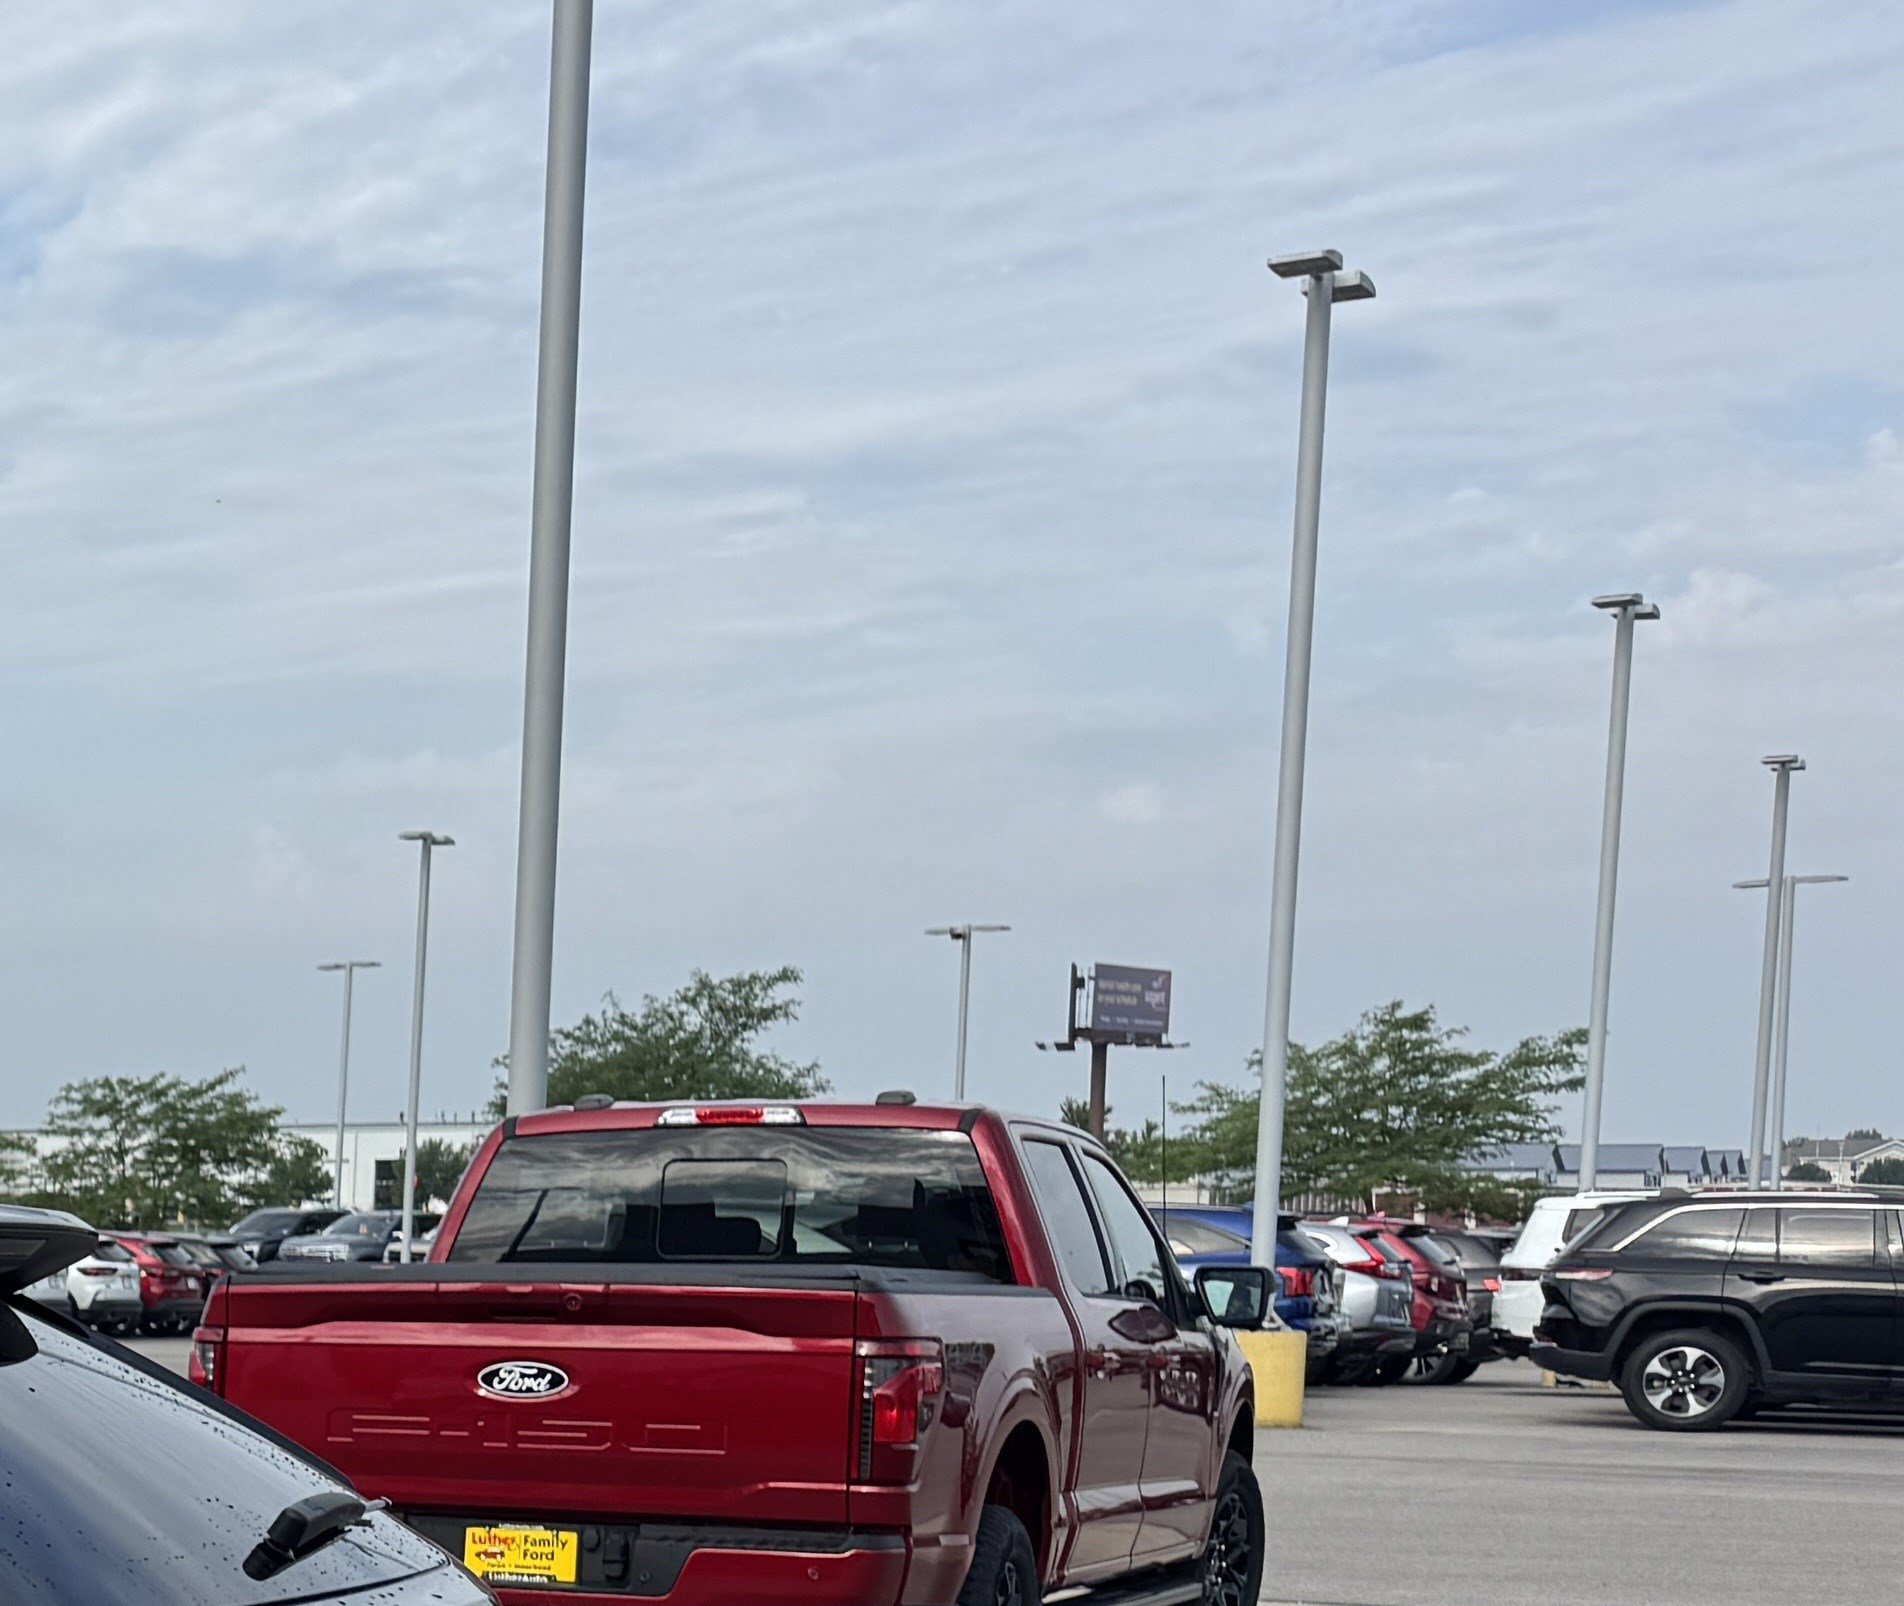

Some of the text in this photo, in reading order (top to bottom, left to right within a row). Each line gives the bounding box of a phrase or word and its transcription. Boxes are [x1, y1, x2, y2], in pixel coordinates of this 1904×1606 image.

[492, 1366, 551, 1392] Ford
[326, 1407, 727, 1455] F-150
[523, 1534, 568, 1550] Family
[522, 1548, 555, 1561] Ford
